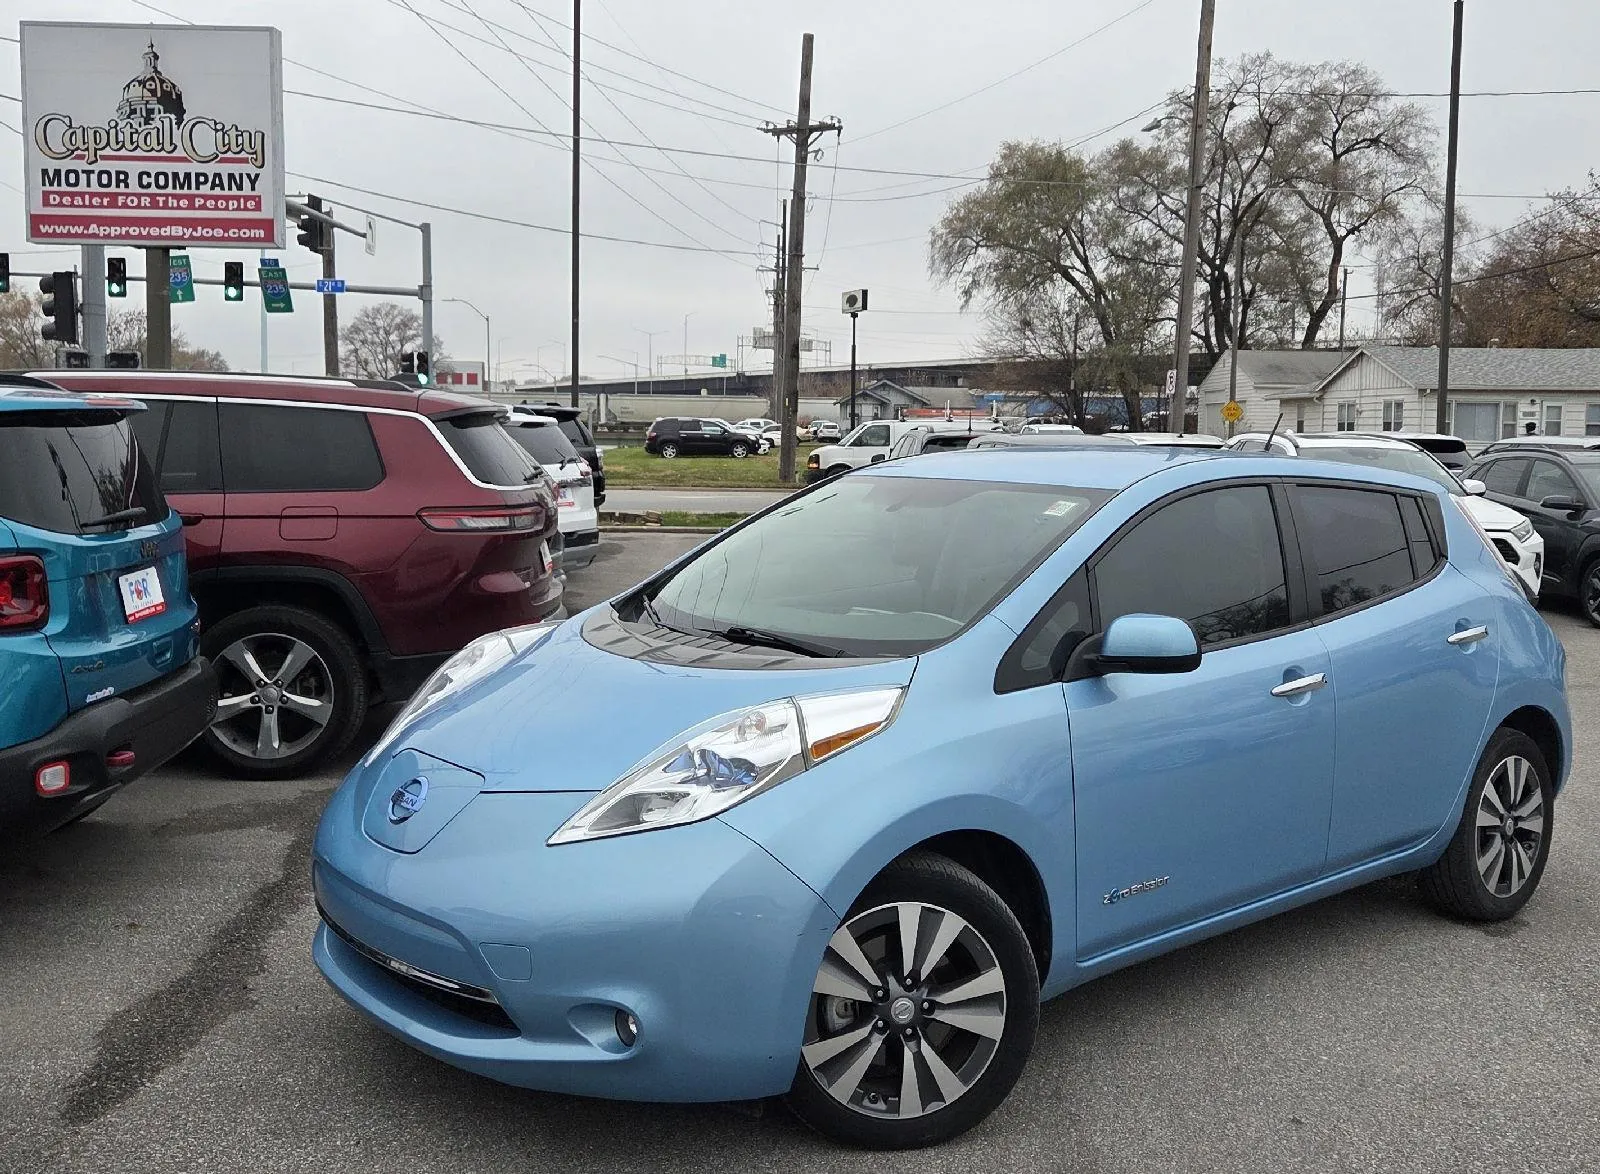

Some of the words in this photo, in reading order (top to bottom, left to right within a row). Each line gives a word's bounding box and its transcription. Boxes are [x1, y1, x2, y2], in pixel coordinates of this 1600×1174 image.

[35, 113, 178, 165] Capital
[181, 116, 265, 169] City
[41, 168, 130, 189] MOTOR
[137, 170, 261, 191] COMPANY
[49, 194, 110, 206] Dealer
[117, 195, 151, 207] FOR
[156, 196, 189, 207] The
[39, 223, 265, 238] www.ApprovedByJoe.com
[169, 258, 187, 266] EST
[169, 271, 188, 283] 235
[261, 270, 283, 278] EAST
[266, 283, 286, 294] 235
